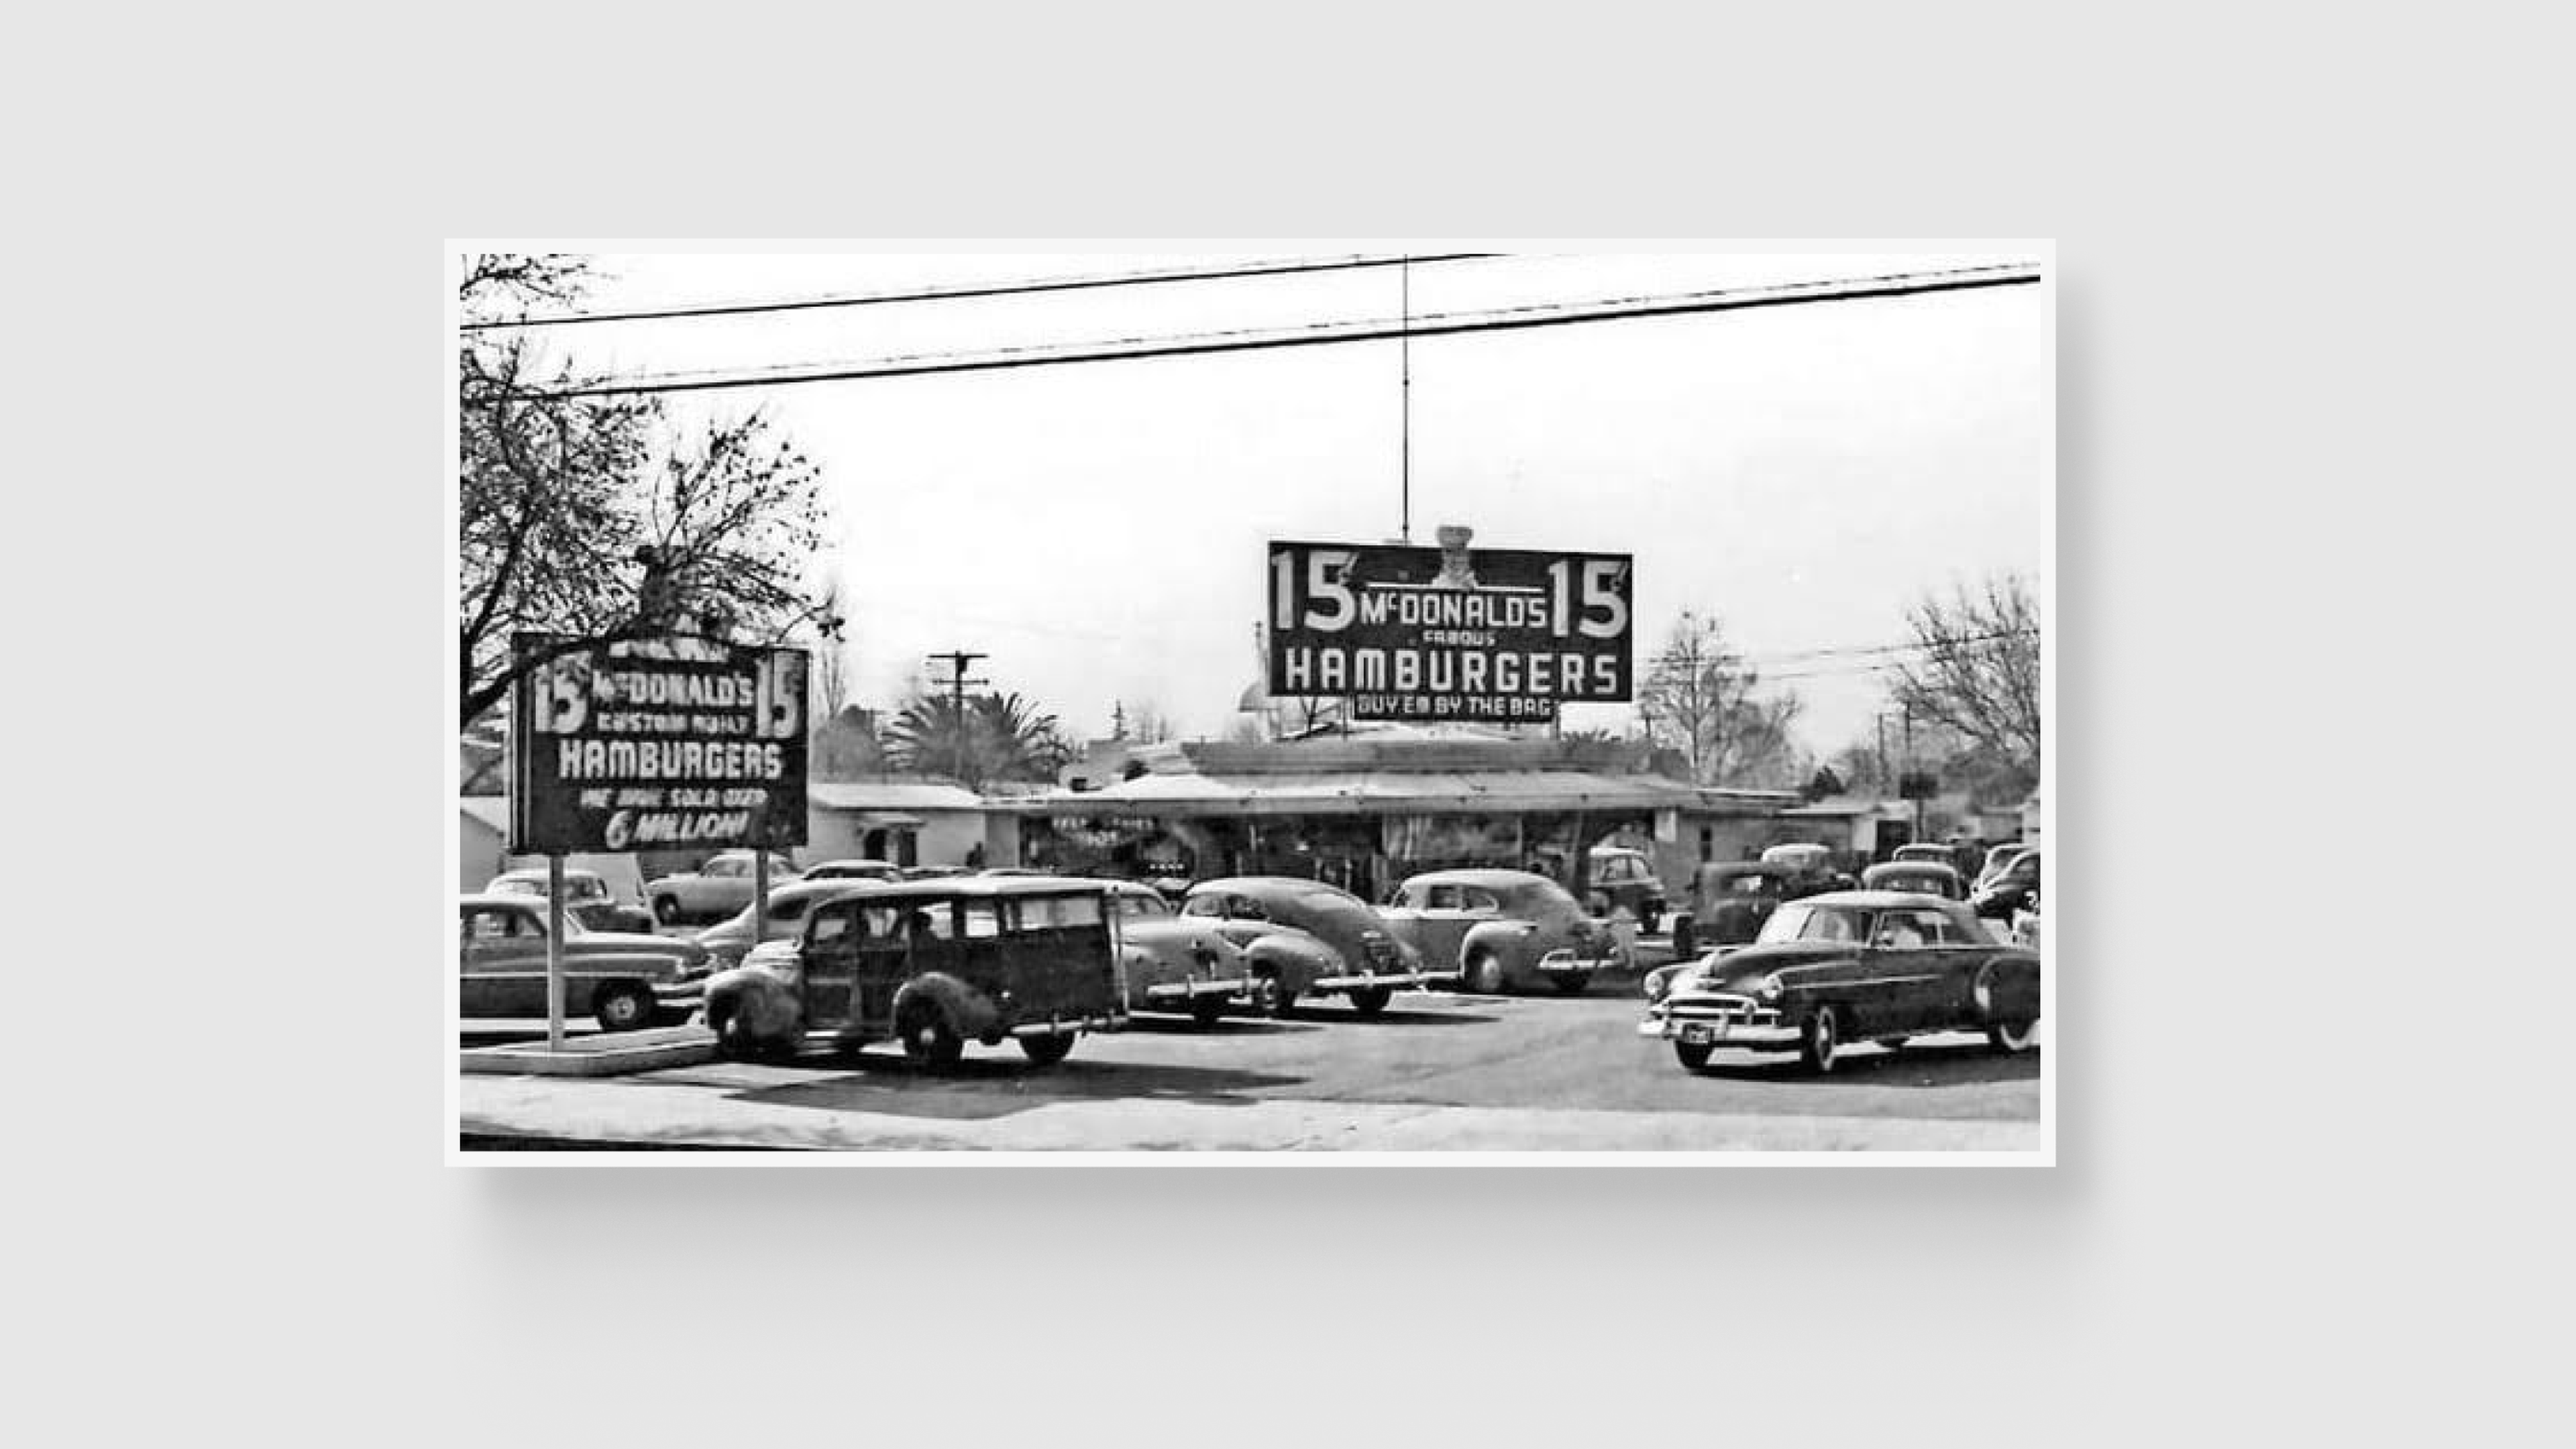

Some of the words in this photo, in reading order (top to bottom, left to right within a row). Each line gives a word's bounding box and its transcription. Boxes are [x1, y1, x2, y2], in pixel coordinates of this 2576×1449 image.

[1285, 648, 1617, 693] HAMBURGERS
[1358, 694, 1397, 713] BUY
[1435, 696, 1461, 714] BY
[1468, 696, 1506, 715] THE
[1510, 698, 1551, 716] BAG
[559, 740, 783, 779] HAMBURGERS
[606, 809, 631, 849] 6
